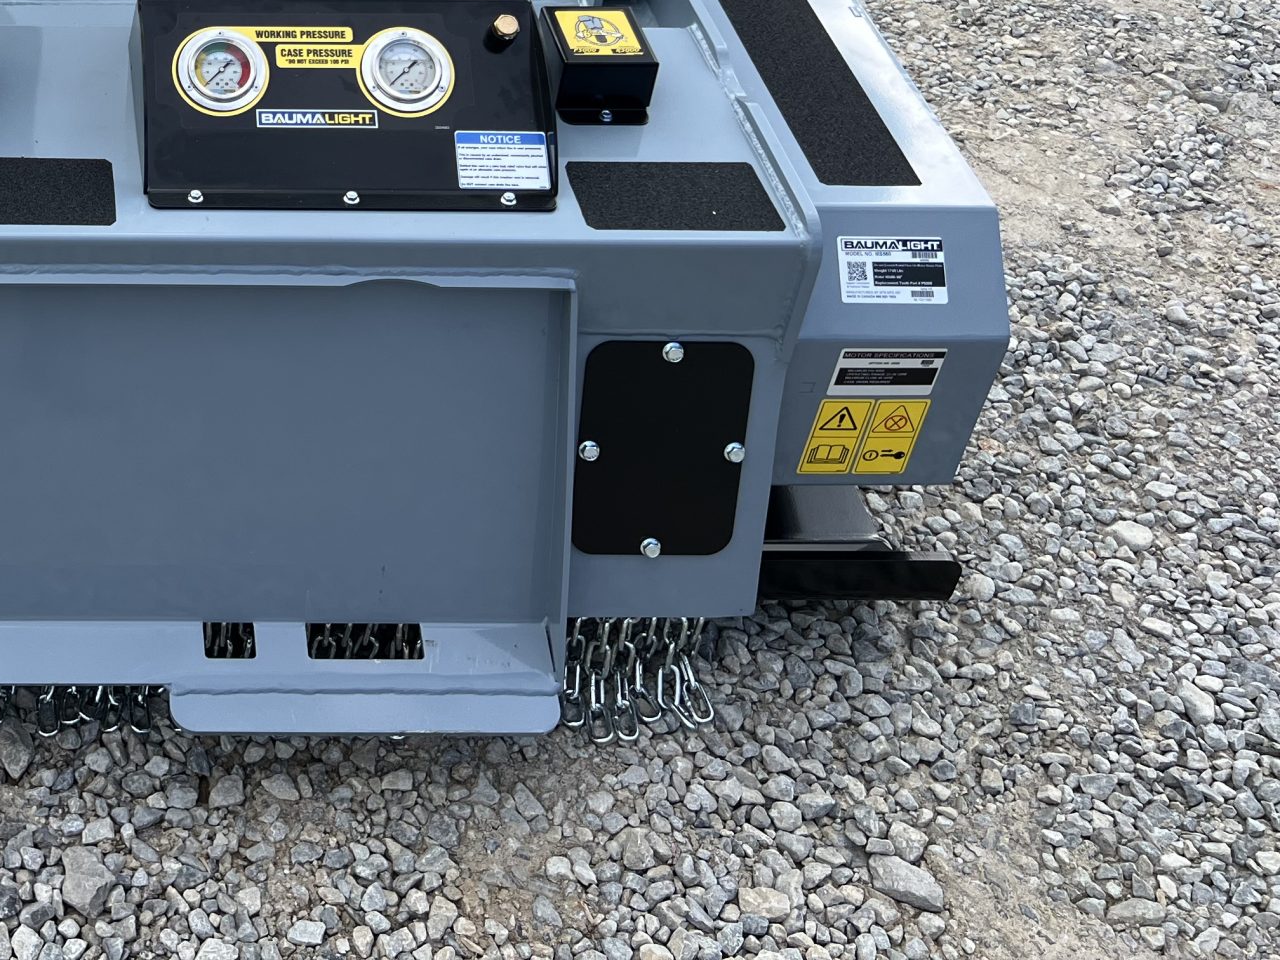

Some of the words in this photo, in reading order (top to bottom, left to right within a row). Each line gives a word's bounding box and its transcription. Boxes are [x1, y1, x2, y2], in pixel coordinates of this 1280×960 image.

[255, 30, 297, 39] WORKING
[300, 30, 346, 39] PRESSURE
[280, 48, 304, 57] CASE
[306, 49, 353, 58] PRESSURE
[261, 113, 373, 124] BAUMALIGHT
[480, 135, 522, 144] NOTICE
[843, 241, 940, 250] BAUMALIGHT
